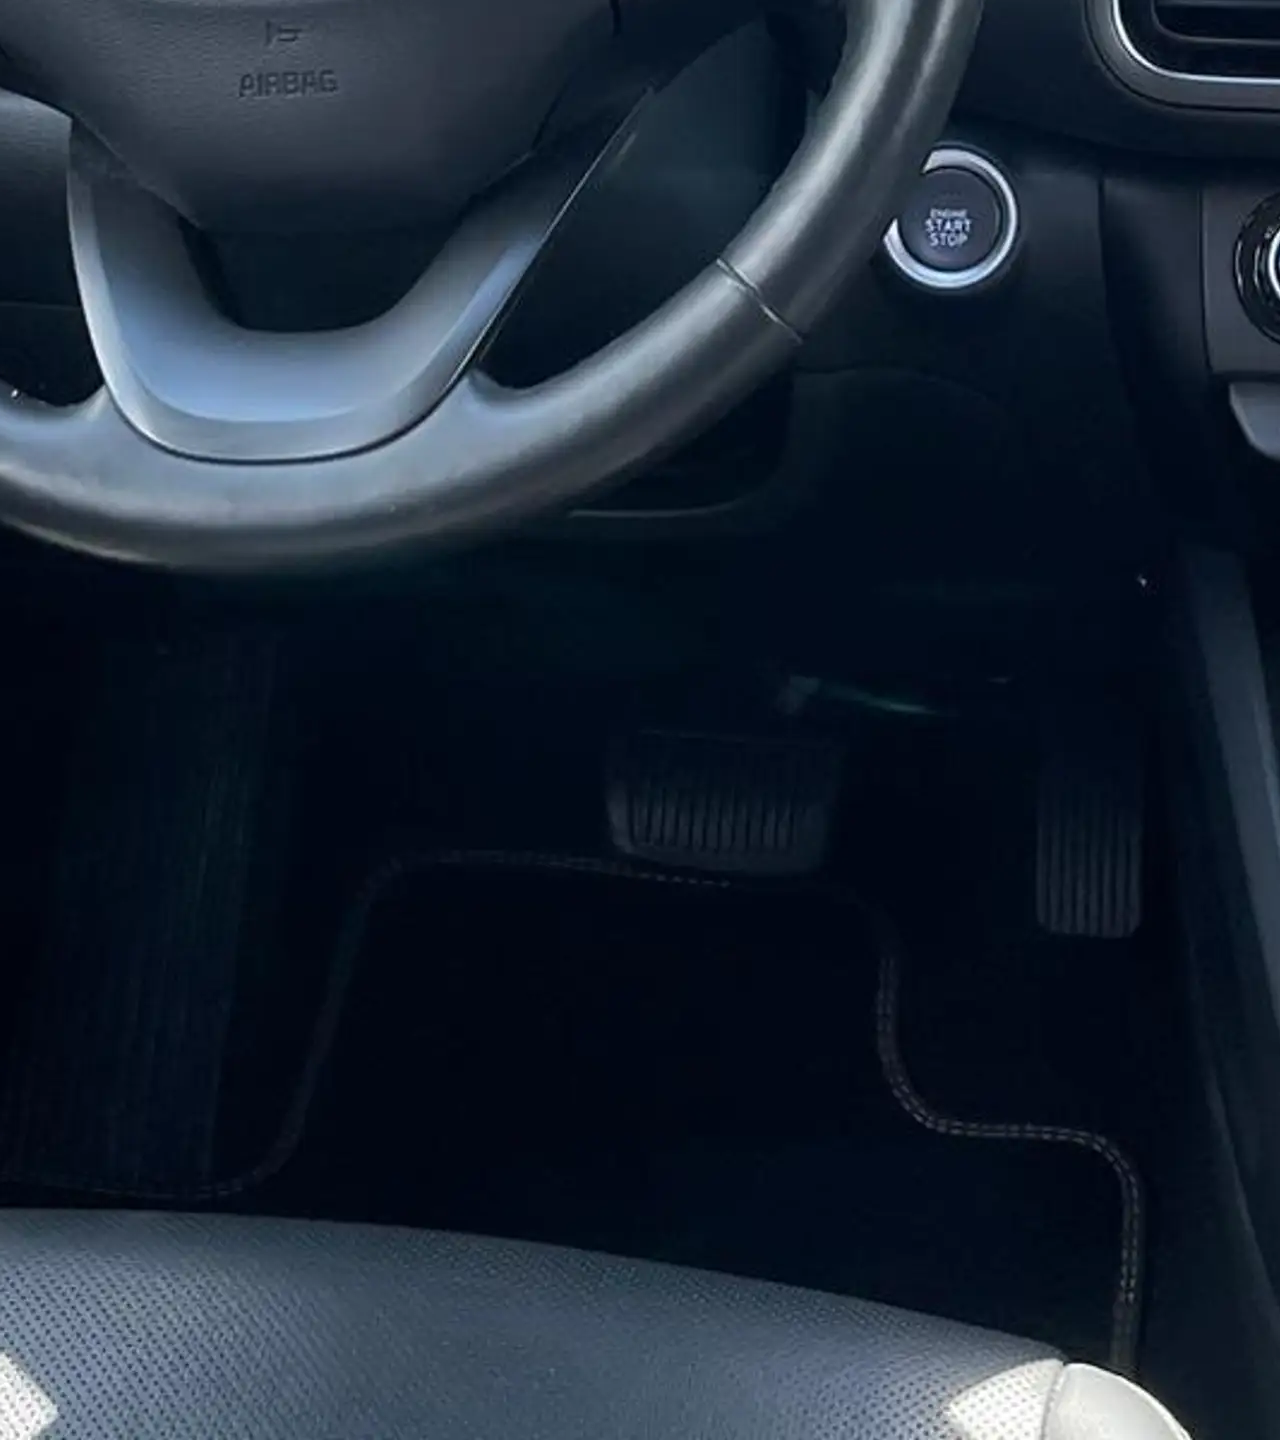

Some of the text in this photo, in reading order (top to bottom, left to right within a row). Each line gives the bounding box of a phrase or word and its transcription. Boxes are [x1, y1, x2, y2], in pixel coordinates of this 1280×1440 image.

[239, 69, 340, 96] AIRBAG
[925, 218, 972, 232] START
[930, 232, 968, 247] STOP
